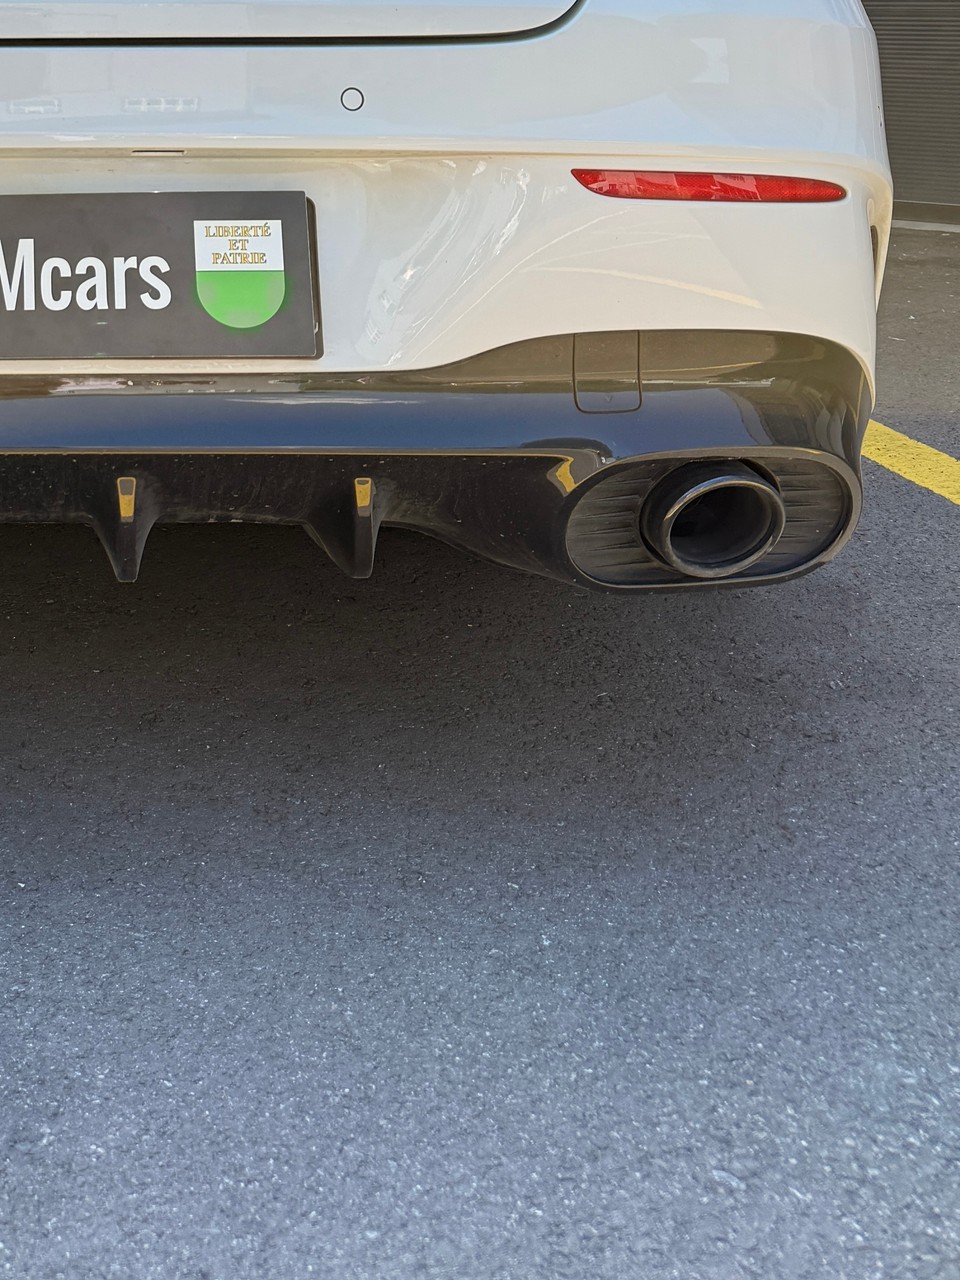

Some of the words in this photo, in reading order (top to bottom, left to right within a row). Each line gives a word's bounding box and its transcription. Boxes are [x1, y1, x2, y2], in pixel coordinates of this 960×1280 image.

[204, 222, 272, 238] LIBERTÉ
[228, 239, 249, 251] ET
[212, 252, 267, 265] PATRIE
